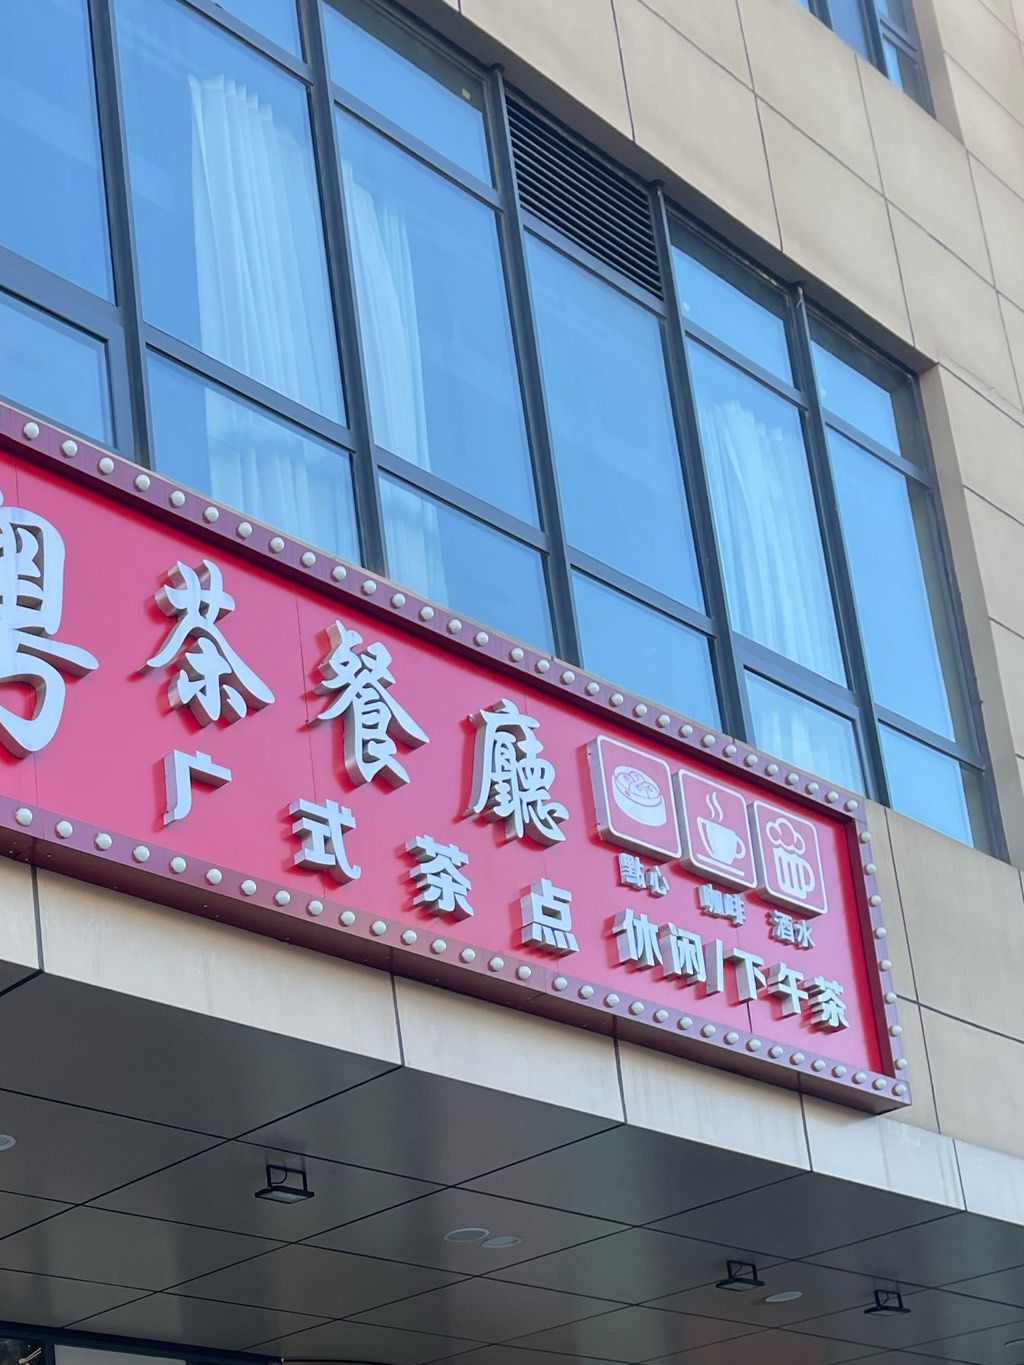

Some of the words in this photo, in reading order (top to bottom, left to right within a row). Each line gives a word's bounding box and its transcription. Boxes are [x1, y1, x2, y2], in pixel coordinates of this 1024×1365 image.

[164, 750, 578, 955] 广式茶点
[618, 853, 669, 898] 點心
[698, 884, 746, 926] 咖啡
[770, 910, 815, 950] 酒水
